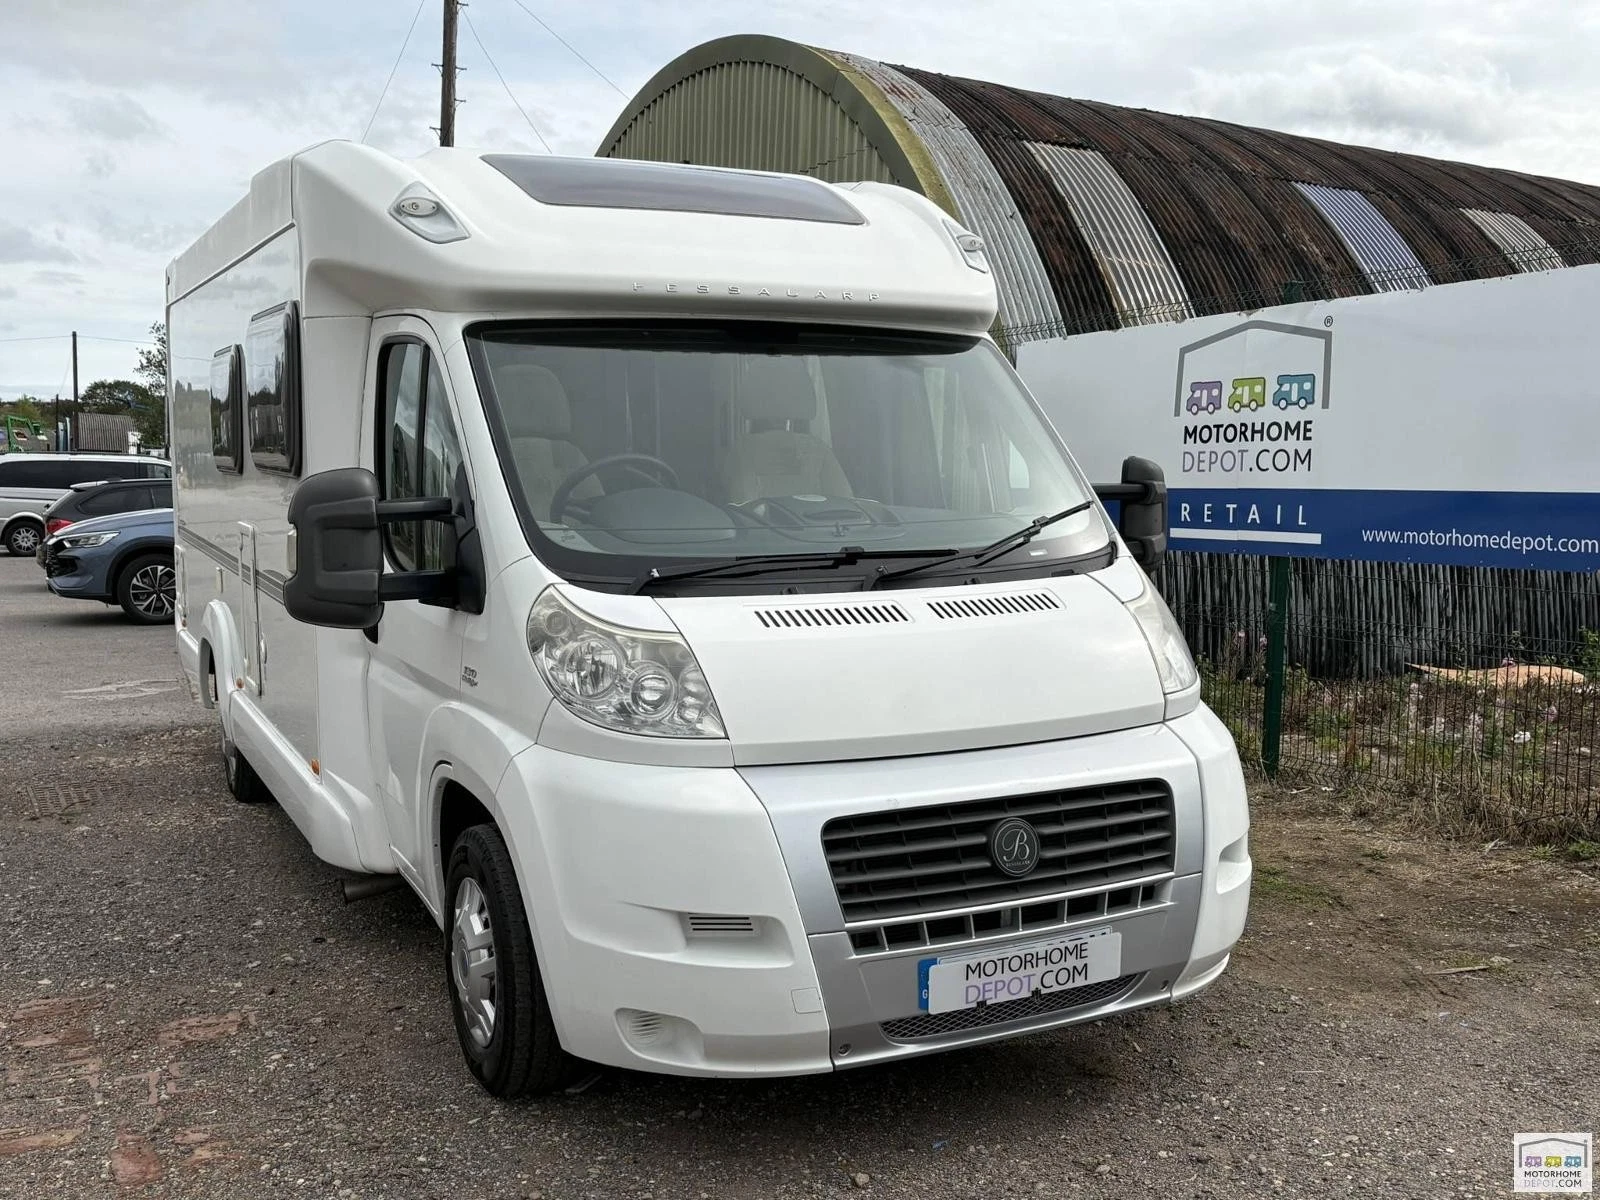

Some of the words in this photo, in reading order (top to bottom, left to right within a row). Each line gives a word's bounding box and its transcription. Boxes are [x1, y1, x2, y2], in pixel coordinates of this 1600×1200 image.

[1183, 420, 1313, 444] MOTORHOME
[1182, 448, 1312, 472] DEPOT.COM
[1180, 502, 1307, 525] RETAIL
[1362, 529, 1599, 554] www.motorhomedepot.com
[965, 941, 1089, 981] MOTORHOME
